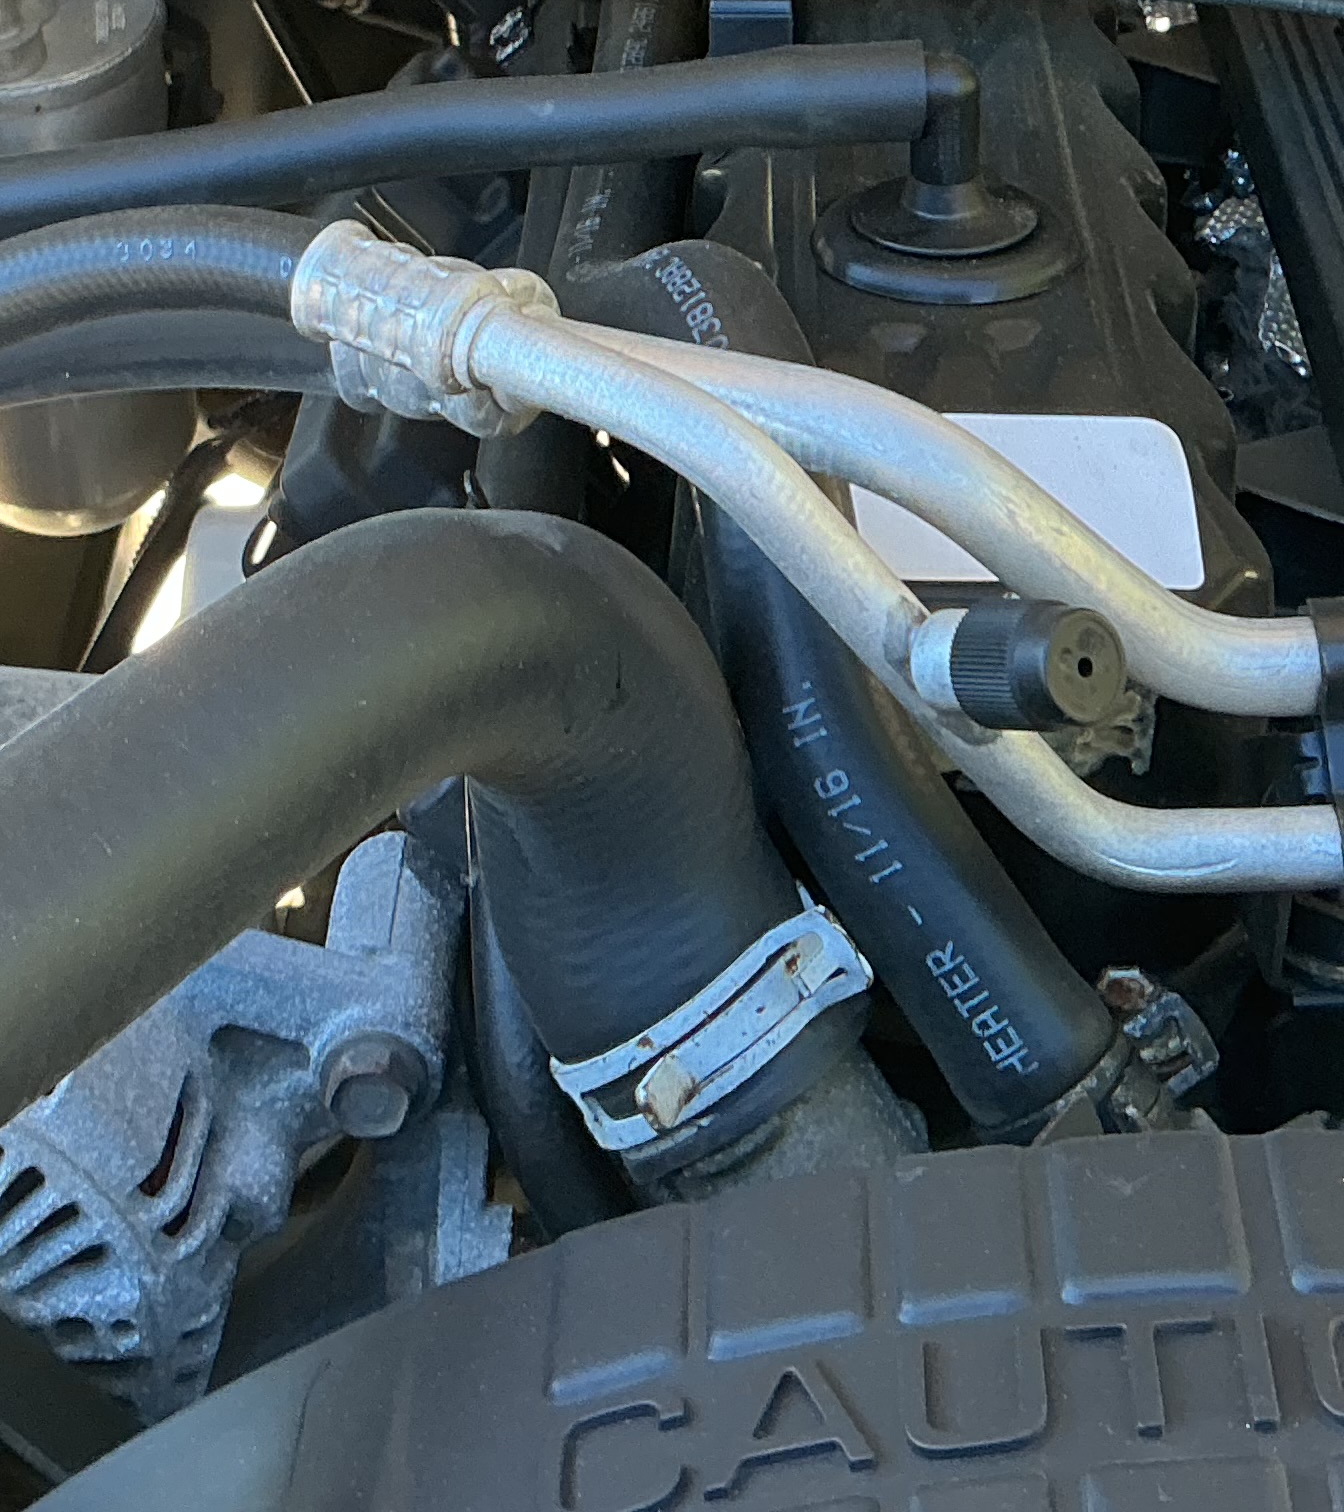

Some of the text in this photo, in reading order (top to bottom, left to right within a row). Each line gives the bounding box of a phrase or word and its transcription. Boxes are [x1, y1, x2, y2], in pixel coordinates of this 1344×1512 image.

[781, 679, 829, 749] IN.
[813, 767, 904, 885] 11/16
[924, 939, 1041, 1077] HEATER
